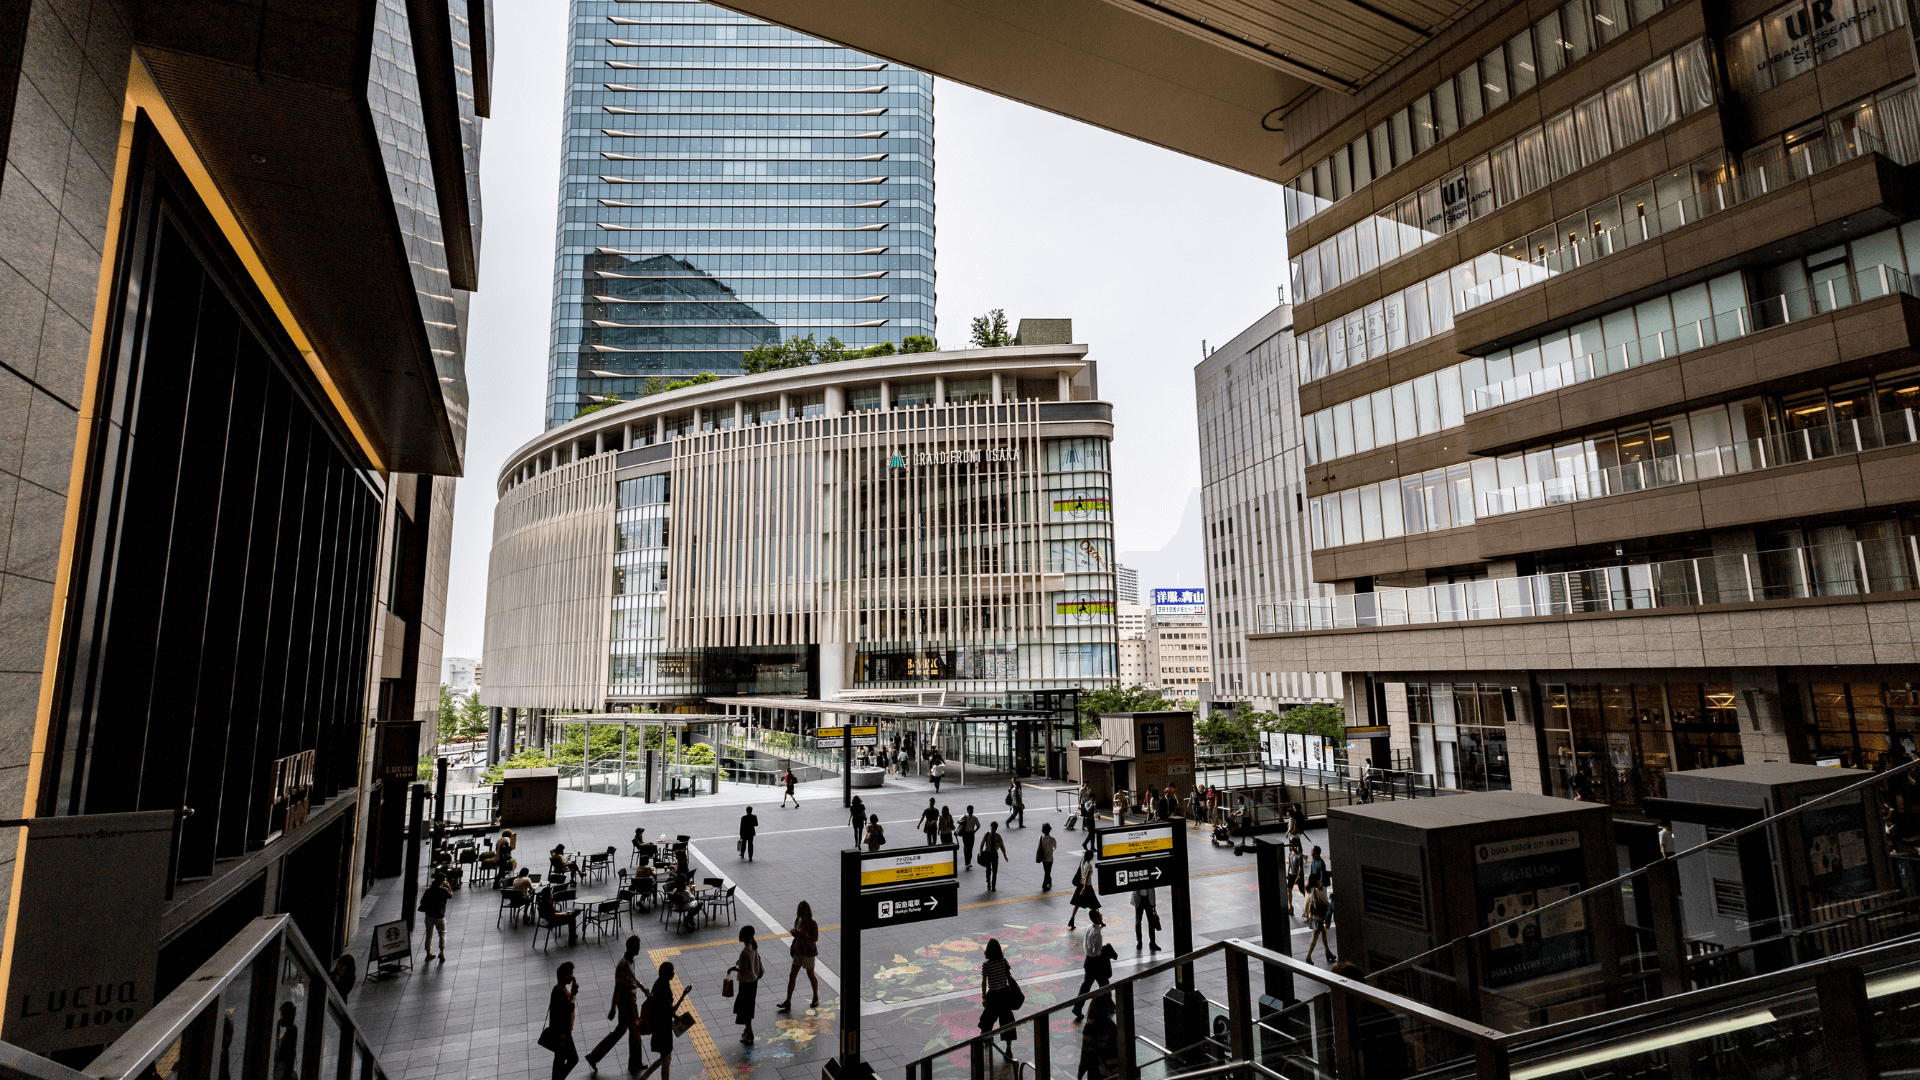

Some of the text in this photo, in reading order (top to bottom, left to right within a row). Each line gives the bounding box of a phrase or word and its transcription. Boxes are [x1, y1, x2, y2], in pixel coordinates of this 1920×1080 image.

[1757, 44, 1800, 71] URBAN
[1793, 38, 1838, 65] Store
[913, 447, 1020, 466] GRAND FRONT OSAKA
[1157, 591, 1204, 603] 洋服の青山
[1491, 848, 1509, 856] OSAKA
[1511, 843, 1532, 854] STATION
[1533, 841, 1545, 850] CITY
[1491, 967, 1513, 978] OSAKA
[1514, 959, 1541, 973] STATION
[65, 1007, 134, 1030] 1100
